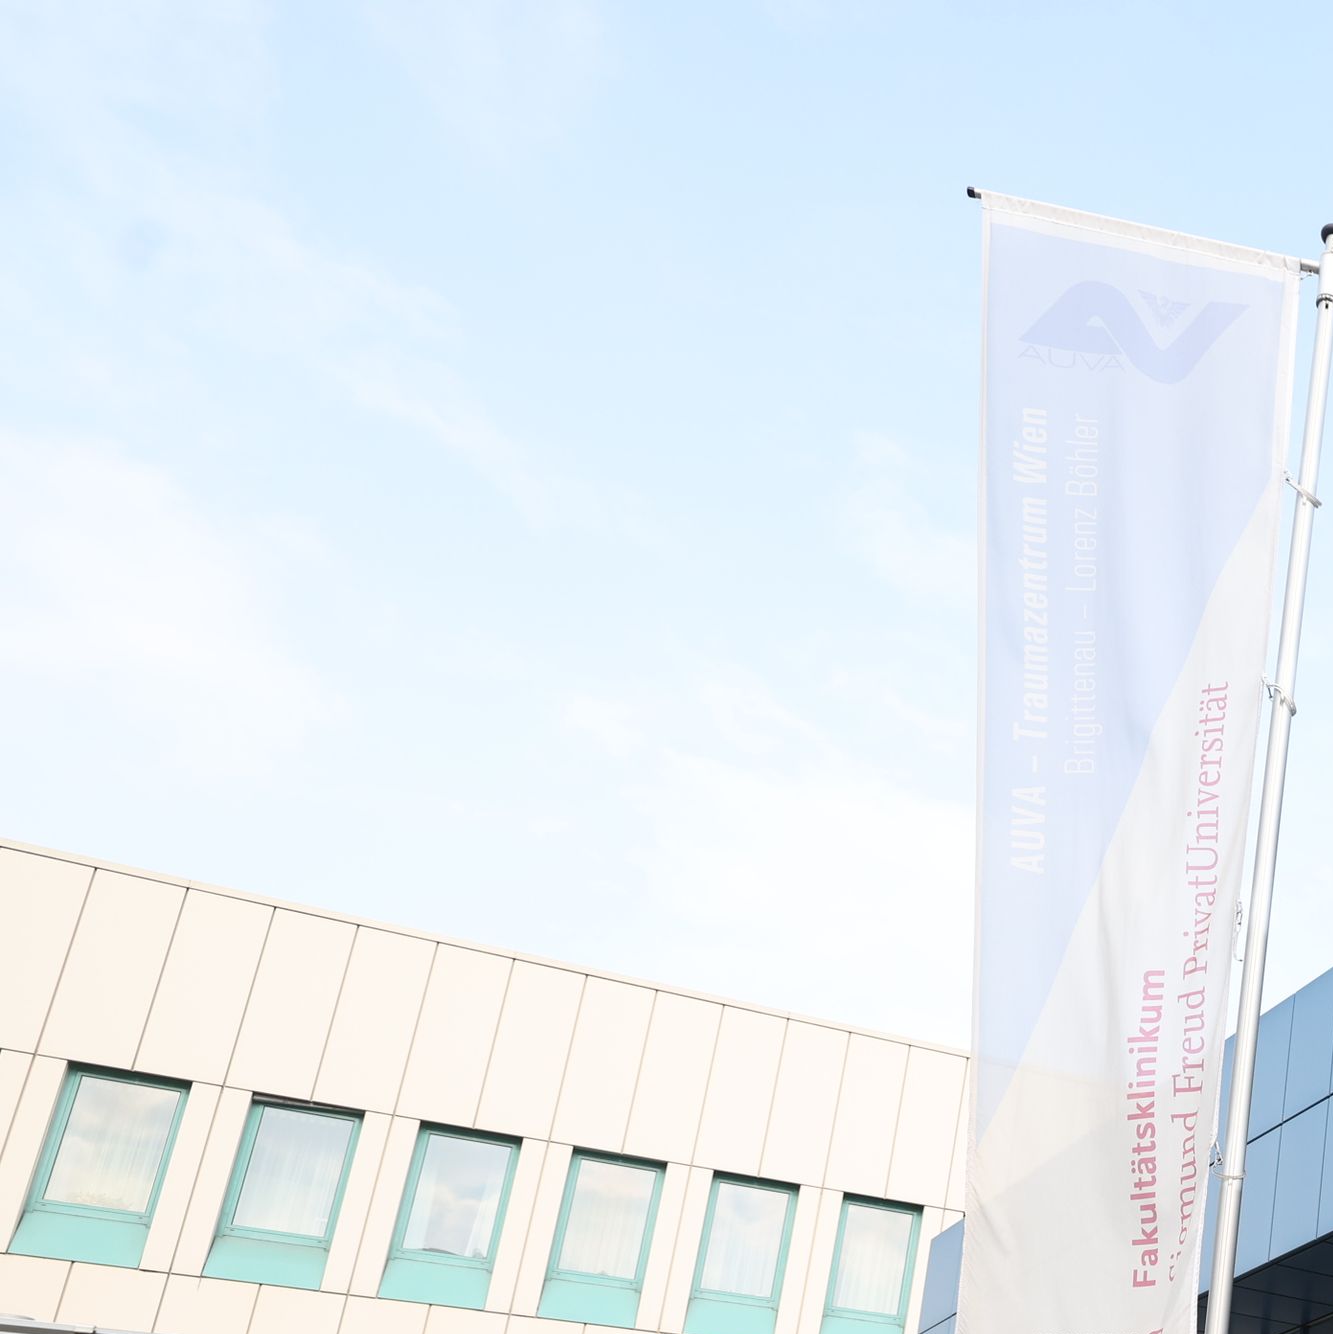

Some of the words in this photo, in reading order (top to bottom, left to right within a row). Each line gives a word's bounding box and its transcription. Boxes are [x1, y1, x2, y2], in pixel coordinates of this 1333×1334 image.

[1017, 345, 1127, 373] AUVA
[1013, 407, 1049, 486] Wien
[1065, 412, 1099, 498] Böhler
[1065, 507, 1098, 593] Lorenz
[1012, 499, 1048, 741] Traumazentrum
[1064, 629, 1102, 776] Brigittenau
[1009, 785, 1046, 875] AUVA
[1181, 680, 1230, 979] PrivatUniversität
[1172, 986, 1206, 1098] Freud
[1126, 968, 1165, 1288] Fakultätsklinikum
